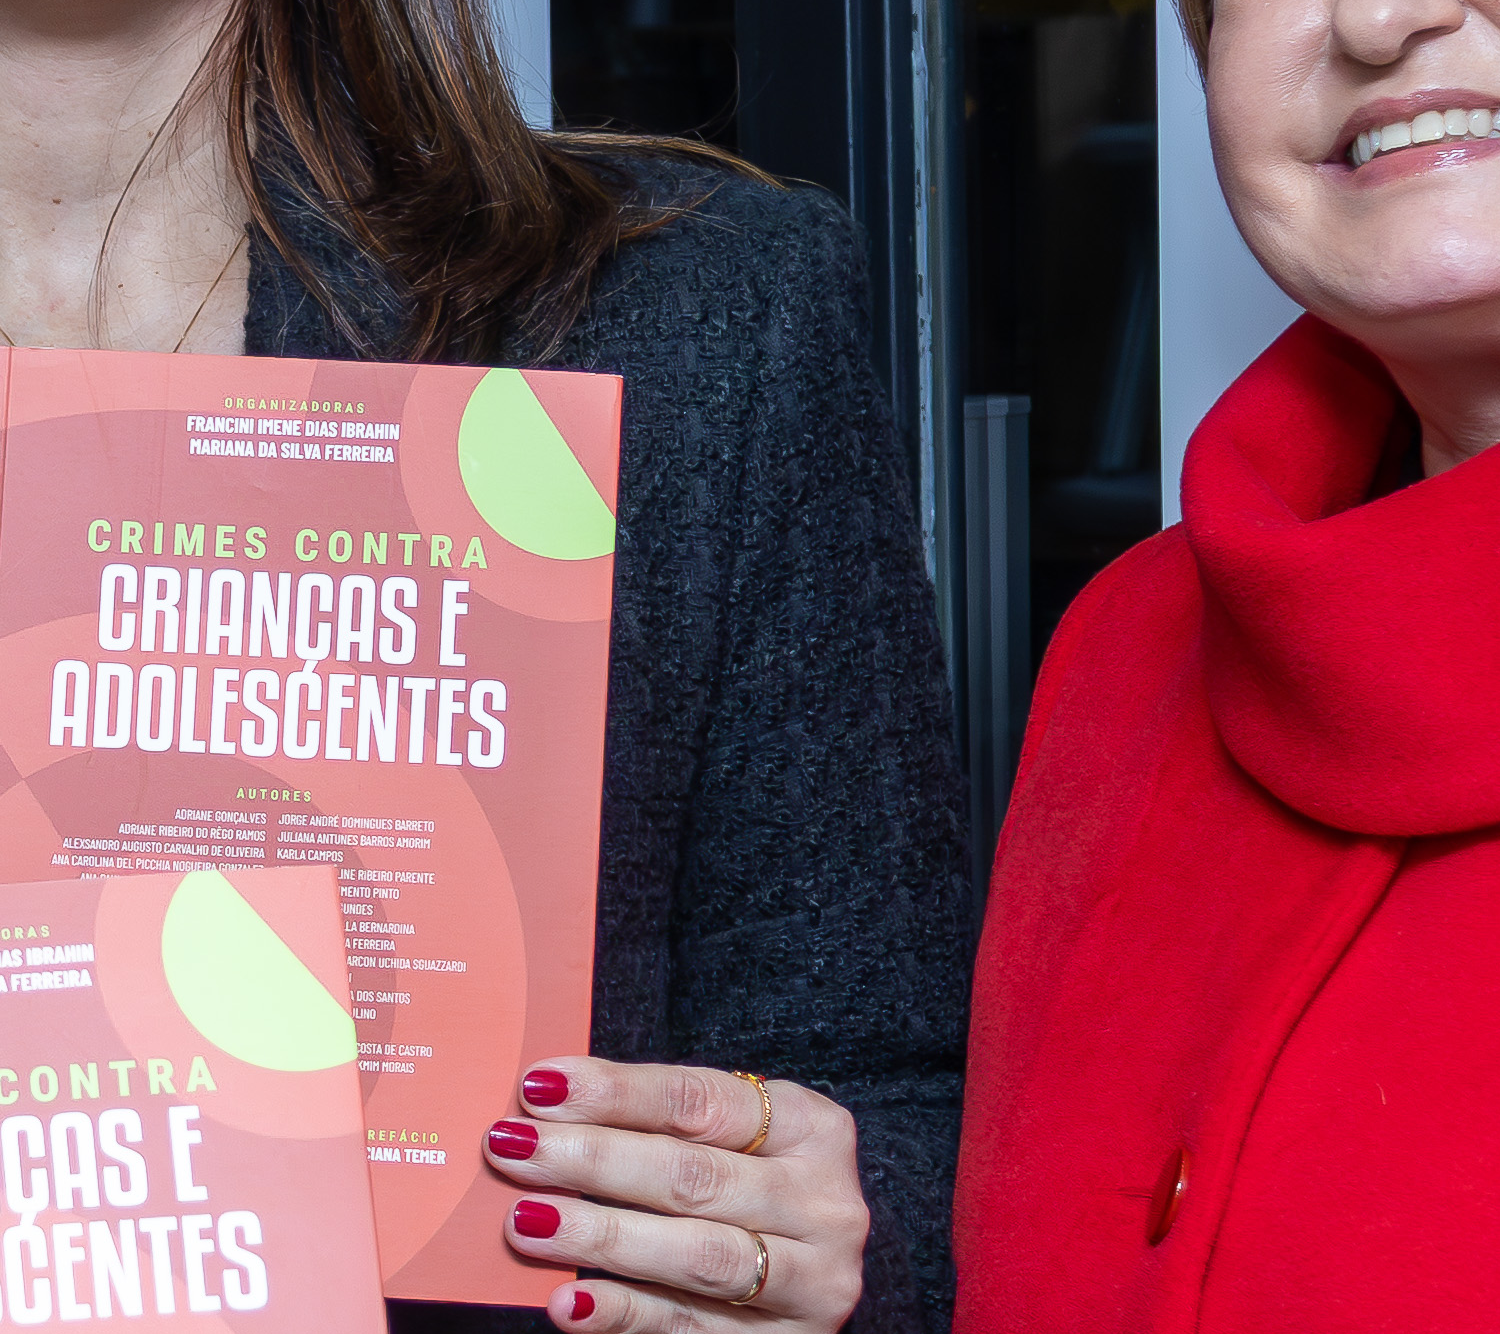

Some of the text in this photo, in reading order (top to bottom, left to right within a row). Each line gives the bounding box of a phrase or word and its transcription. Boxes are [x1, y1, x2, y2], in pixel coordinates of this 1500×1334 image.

[224, 397, 364, 413] ORGANIZADORAS
[186, 415, 399, 440] FRANCINI IMENE DIAS IBRAHIN
[189, 438, 394, 462] MARIANA DA SILVA FERREIRA
[87, 519, 487, 568] CRIMES CONTRA
[98, 563, 470, 670] CRIANÇAS E
[49, 660, 507, 768] ADOLESCENTES
[236, 787, 311, 802] AUTORES
[174, 808, 266, 824] ADRIANE GONÇALVES
[277, 813, 434, 832] JORGE ANDRÉ DOMINGUES BARRETO
[118, 823, 266, 841] ADRIANE RIBEIRO DO RÊGO RAMOS
[277, 831, 430, 848] JULIANA ANTUNES BARROS AMORIM
[62, 837, 265, 858] ALEXSANDRO AUGUSTO CARVALHO DE OLIVEIRA
[276, 847, 343, 862] KARLA CAMPOS
[50, 853, 170, 870] ANA CAROLINA DEL PICCHIA
[357, 869, 435, 884] RIBEIRO PARENTE
[372, 887, 399, 899] PINTO
[358, 921, 415, 934] BERNARDINA
[352, 937, 395, 950] FERREIRA
[25, 943, 94, 966] IBRAHIN
[378, 957, 466, 972] UCHIDA SGUAZZARDI
[10, 968, 92, 991] FERREIRA
[356, 990, 410, 1004] DOS SANTOS
[356, 1043, 432, 1057] COSTA DE CASTRO
[381, 1061, 414, 1073] MORAIS
[367, 1128, 438, 1143] REFÁCIO
[169, 1105, 208, 1204] E
[403, 1148, 446, 1164] TEMER
